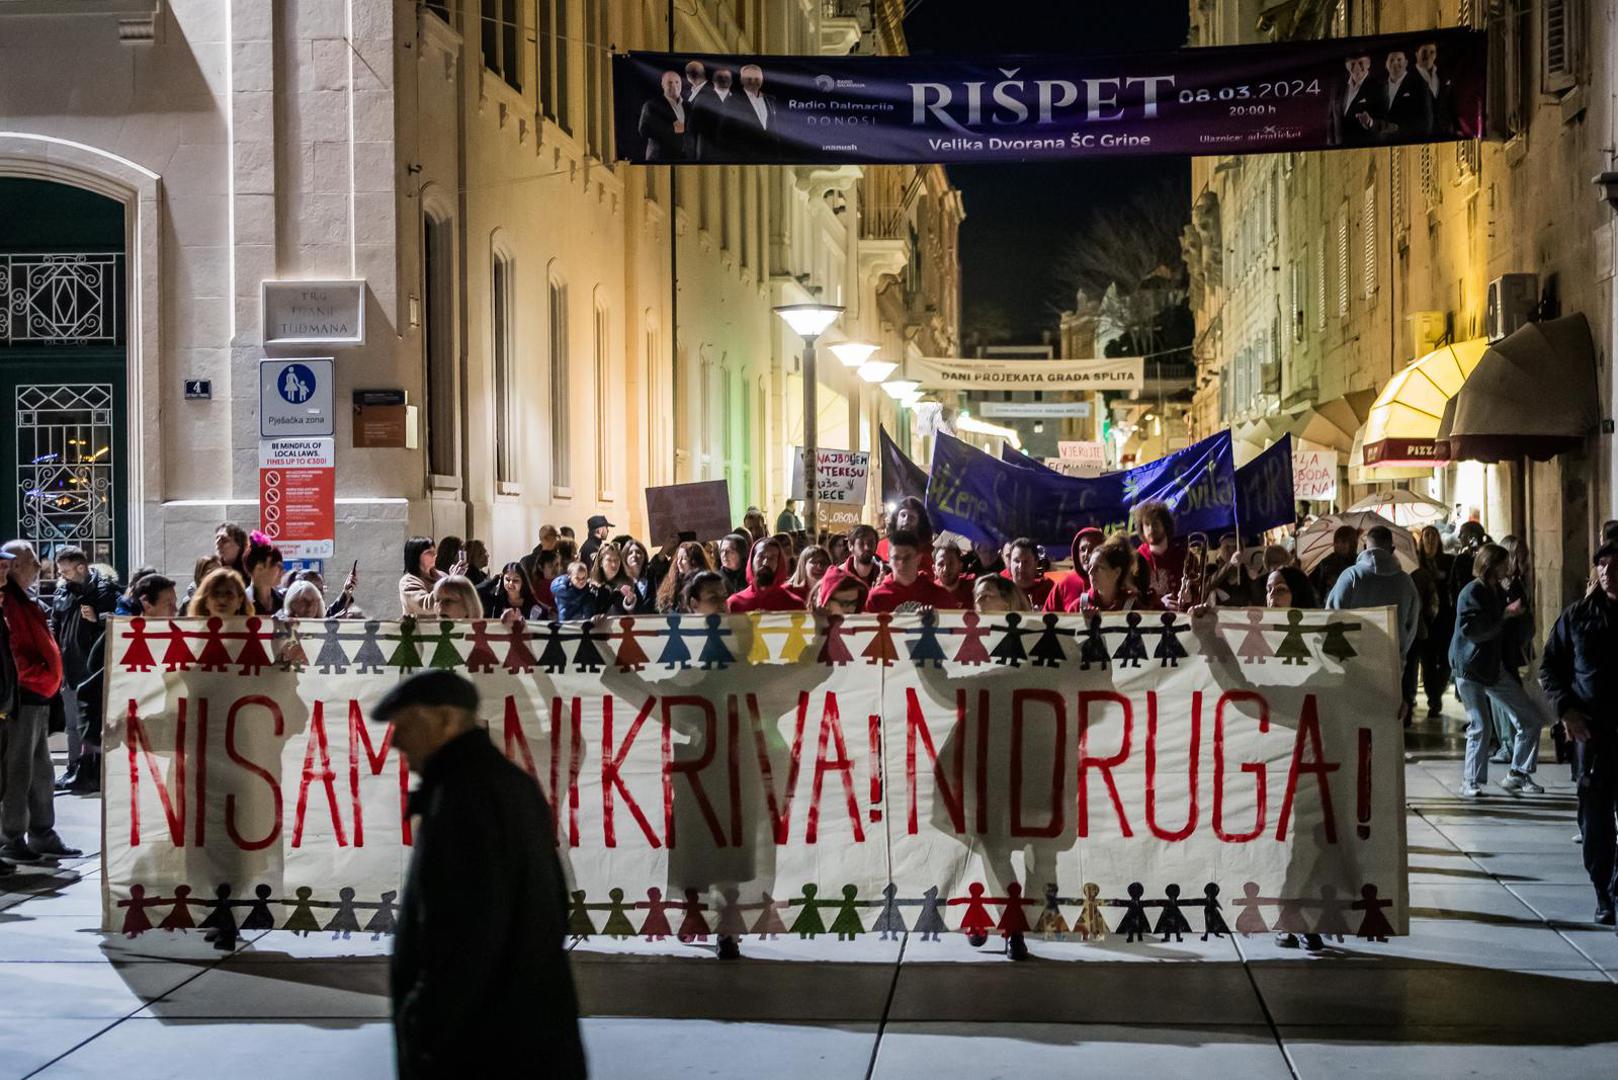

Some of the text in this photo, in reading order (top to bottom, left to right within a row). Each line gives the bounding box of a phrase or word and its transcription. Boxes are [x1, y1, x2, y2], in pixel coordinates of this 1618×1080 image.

[1178, 78, 1321, 103] 08.03.2024
[788, 99, 827, 110] Radio
[907, 67, 1176, 136] RIŠPET
[1229, 105, 1277, 116] 20:00 h
[807, 115, 876, 126] DONOSI
[928, 132, 1151, 151] Velika Dvorana ŠC Gripe
[941, 371, 1135, 383] DANI PROJEKATA GRADA SPLITA
[192, 381, 201, 393] 4
[305, 416, 325, 425] zona
[280, 442, 311, 450] MINDFUL
[312, 441, 322, 450] OF
[274, 450, 297, 458] LOCAL
[816, 466, 865, 478] NTERESU
